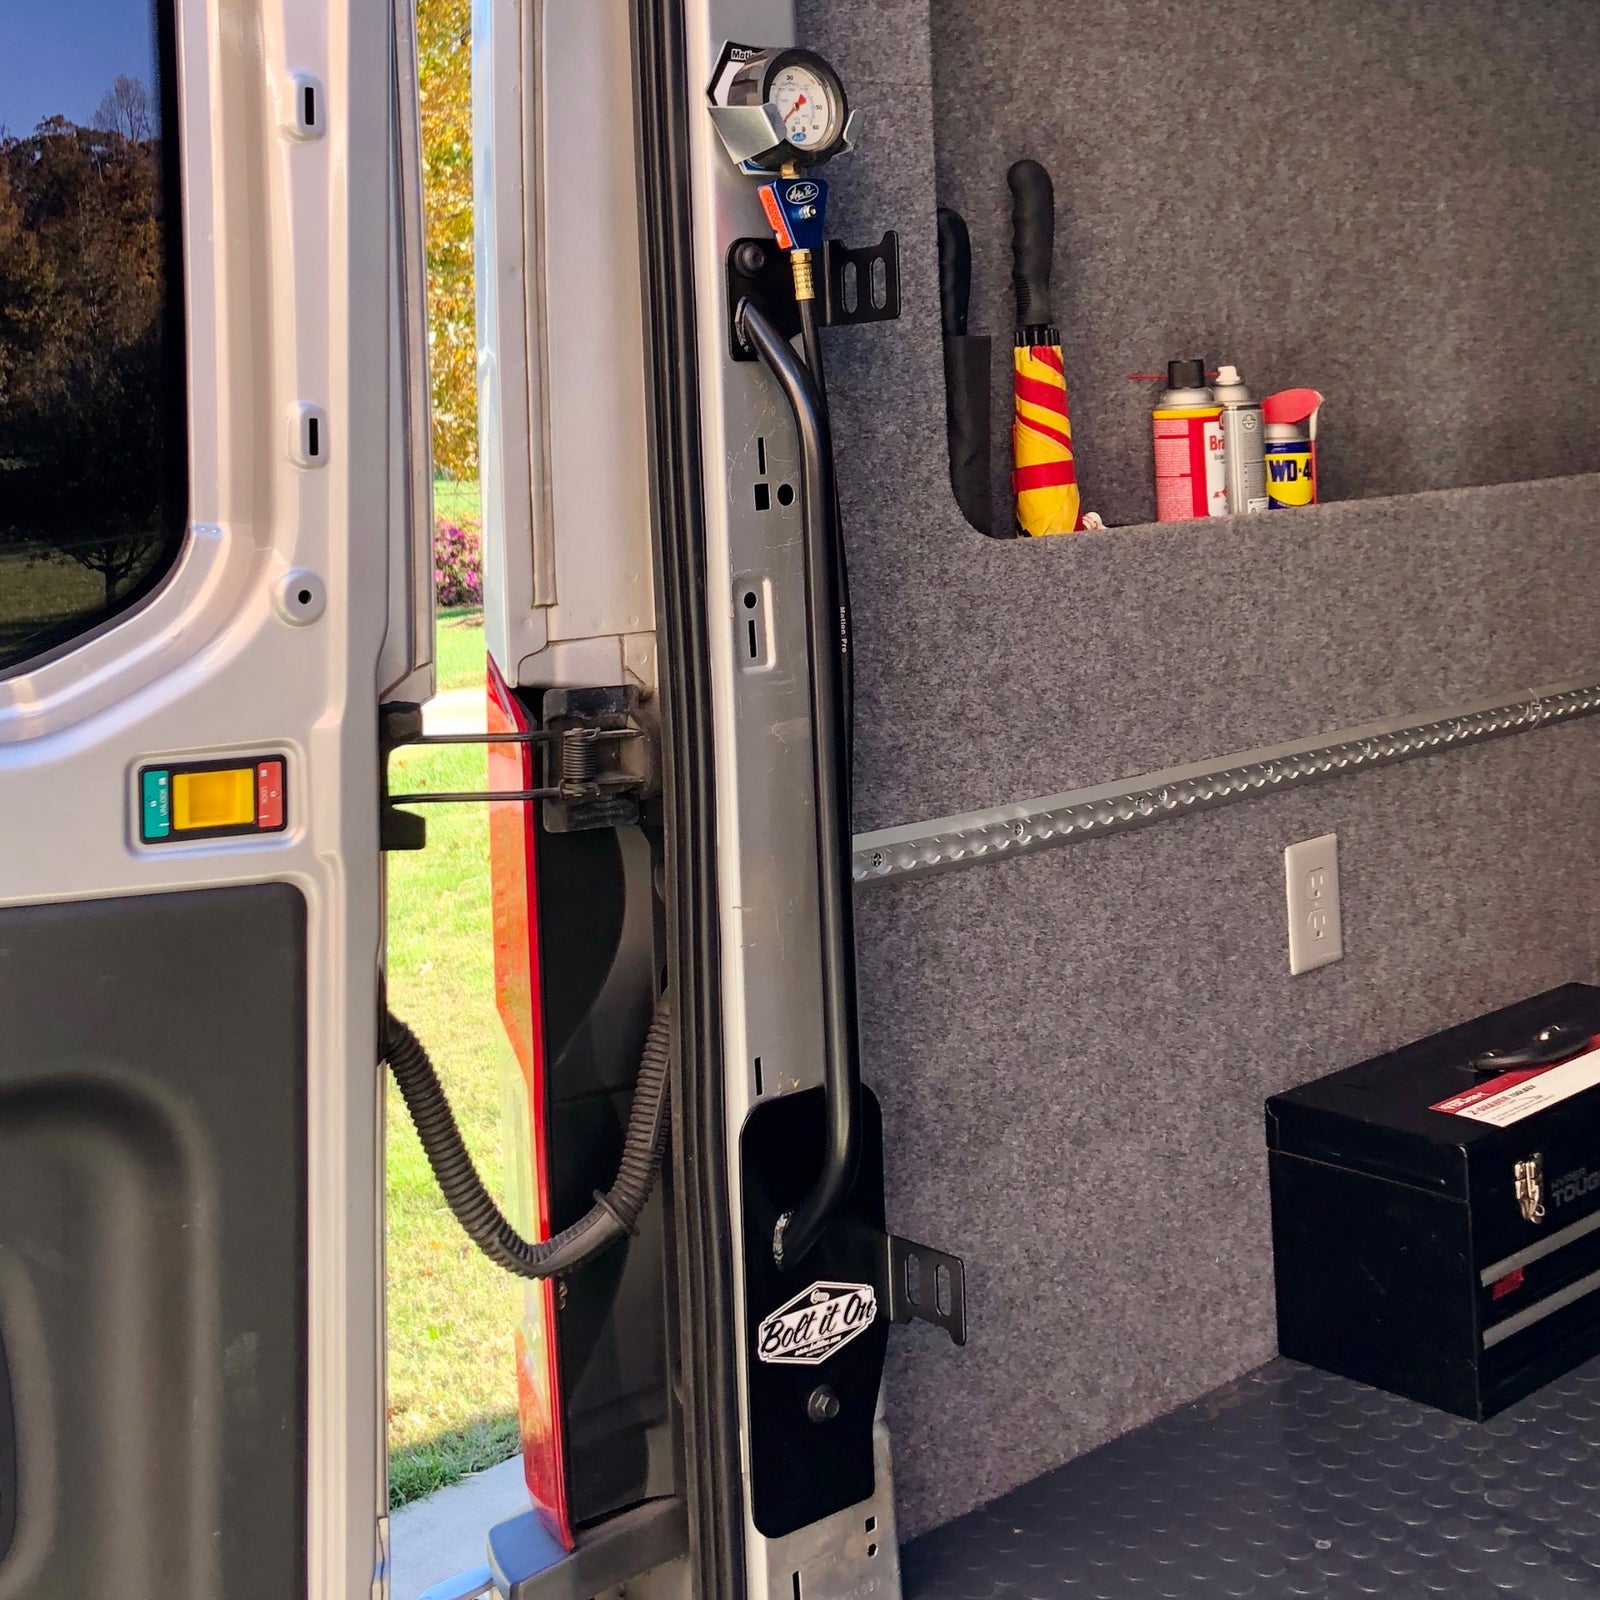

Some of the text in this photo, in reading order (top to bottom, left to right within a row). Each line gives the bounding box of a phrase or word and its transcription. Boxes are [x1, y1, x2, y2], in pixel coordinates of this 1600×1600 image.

[1552, 1170, 1600, 1207] TOUG
[761, 1310, 817, 1353] Bolt
[819, 1303, 841, 1336] it
[843, 1293, 874, 1326] On
